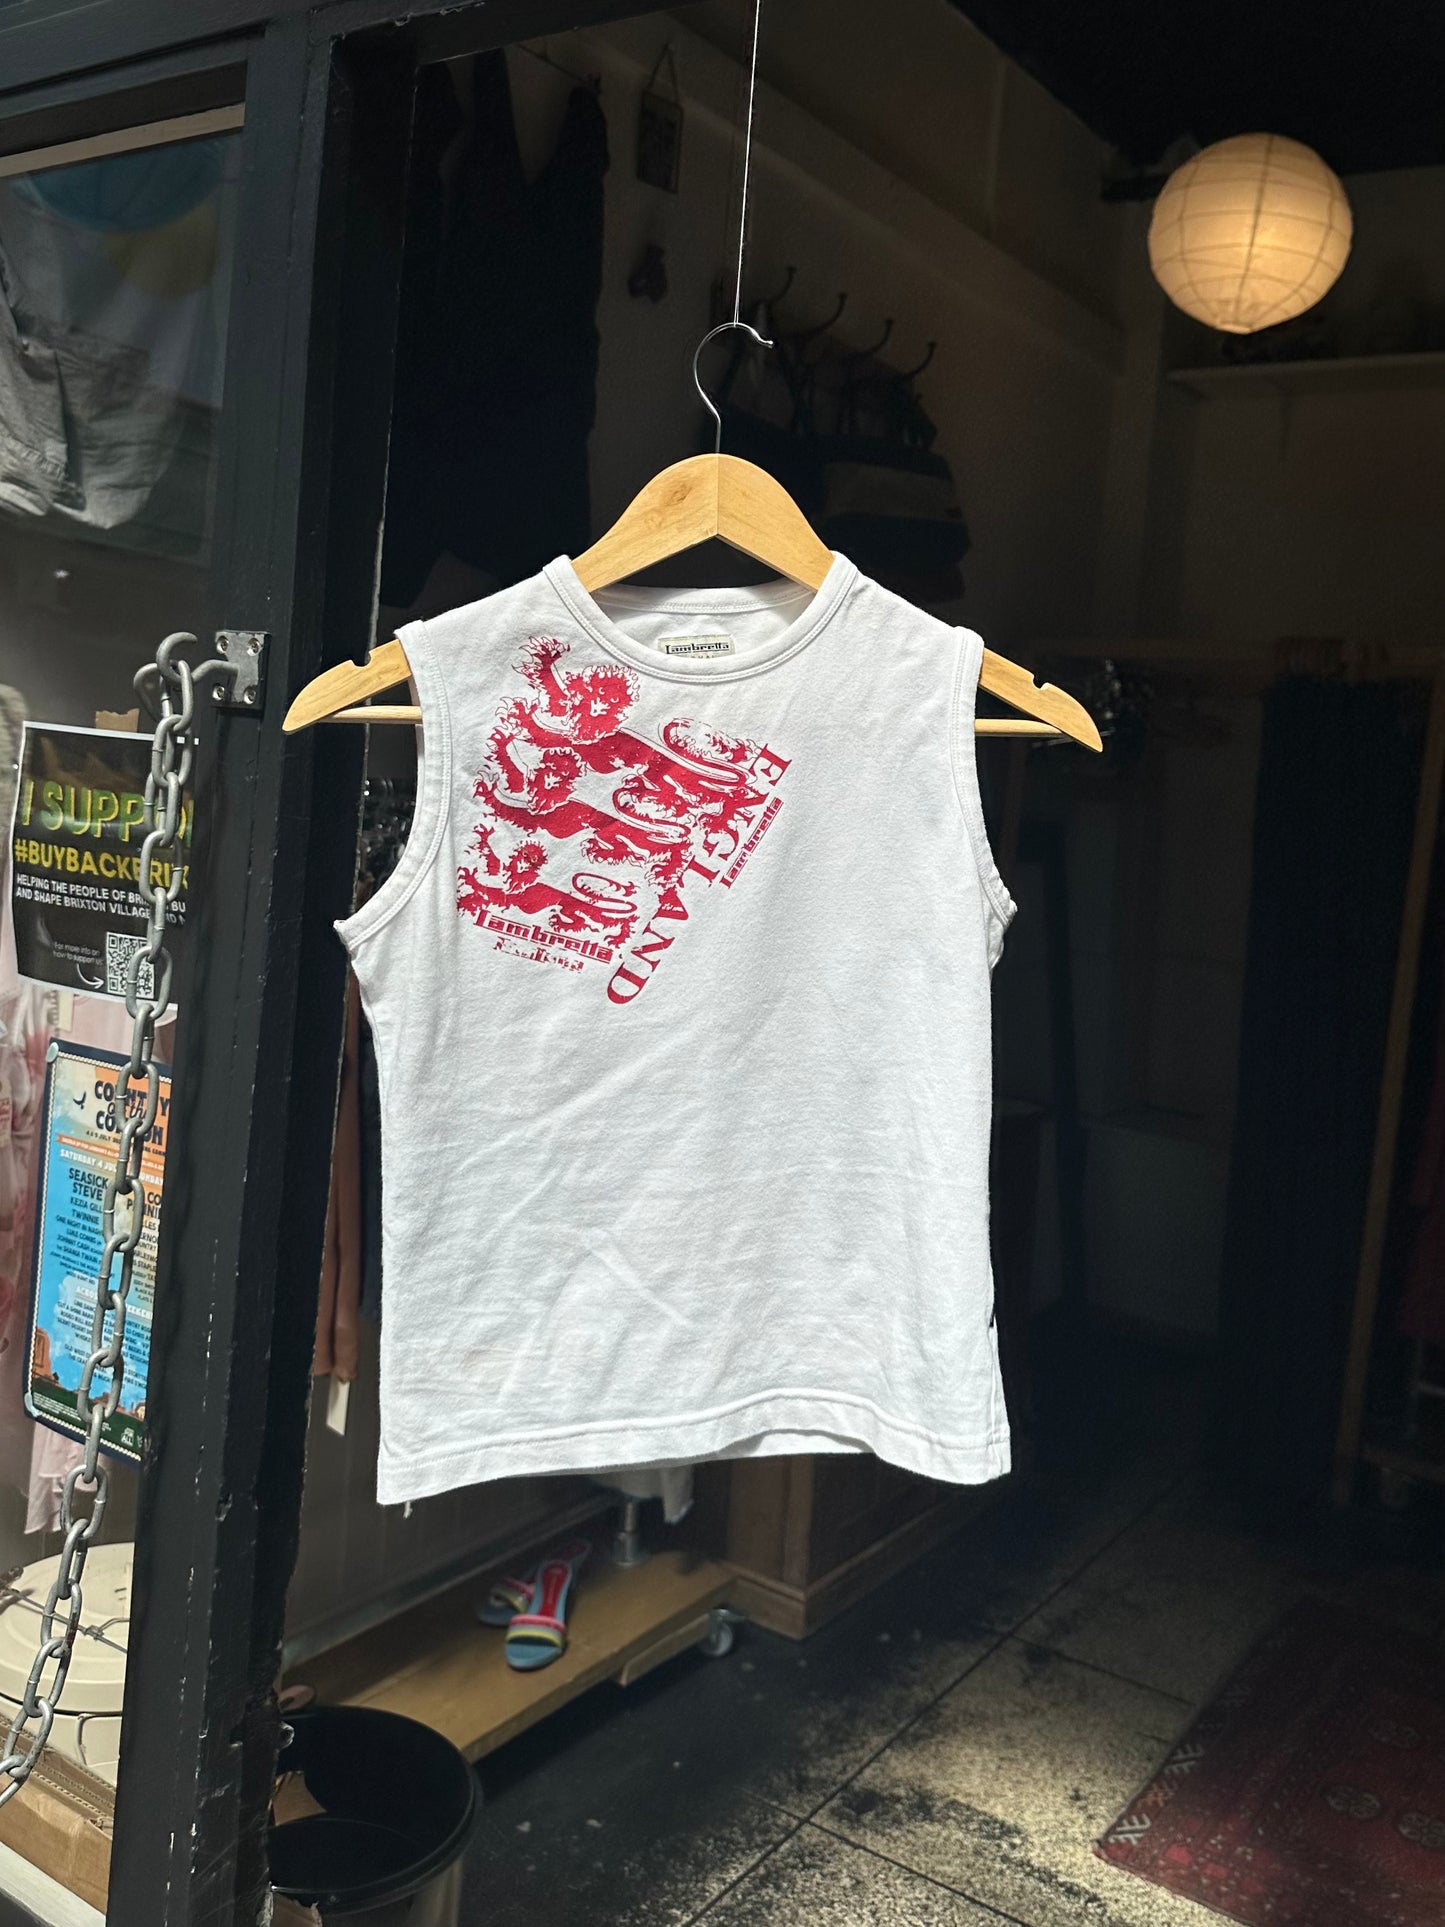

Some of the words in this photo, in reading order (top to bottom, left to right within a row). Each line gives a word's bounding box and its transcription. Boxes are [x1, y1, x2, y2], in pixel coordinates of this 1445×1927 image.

[665, 643, 729, 654] Lambretta
[22, 780, 34, 826] I
[40, 781, 194, 847] SUPP
[719, 797, 784, 890] Lambretta
[607, 743, 792, 1005] ENGLAND
[16, 886, 33, 900] AND
[34, 889, 62, 906] SHAPE
[64, 895, 106, 912] BRIXTON
[108, 902, 150, 919] VILLAGE
[17, 873, 50, 891] HELPING
[50, 880, 68, 895] THE
[69, 883, 109, 900] PEOPLE
[112, 889, 125, 901] OF
[171, 900, 186, 913] BU
[473, 910, 614, 964] Lambretta
[95, 1080, 170, 1116] CONTY
[61, 1149, 97, 1166] SATURDAY
[104, 1162, 117, 1173] JUL
[69, 1168, 109, 1190] SEASICK
[72, 1182, 103, 1201] STEVE
